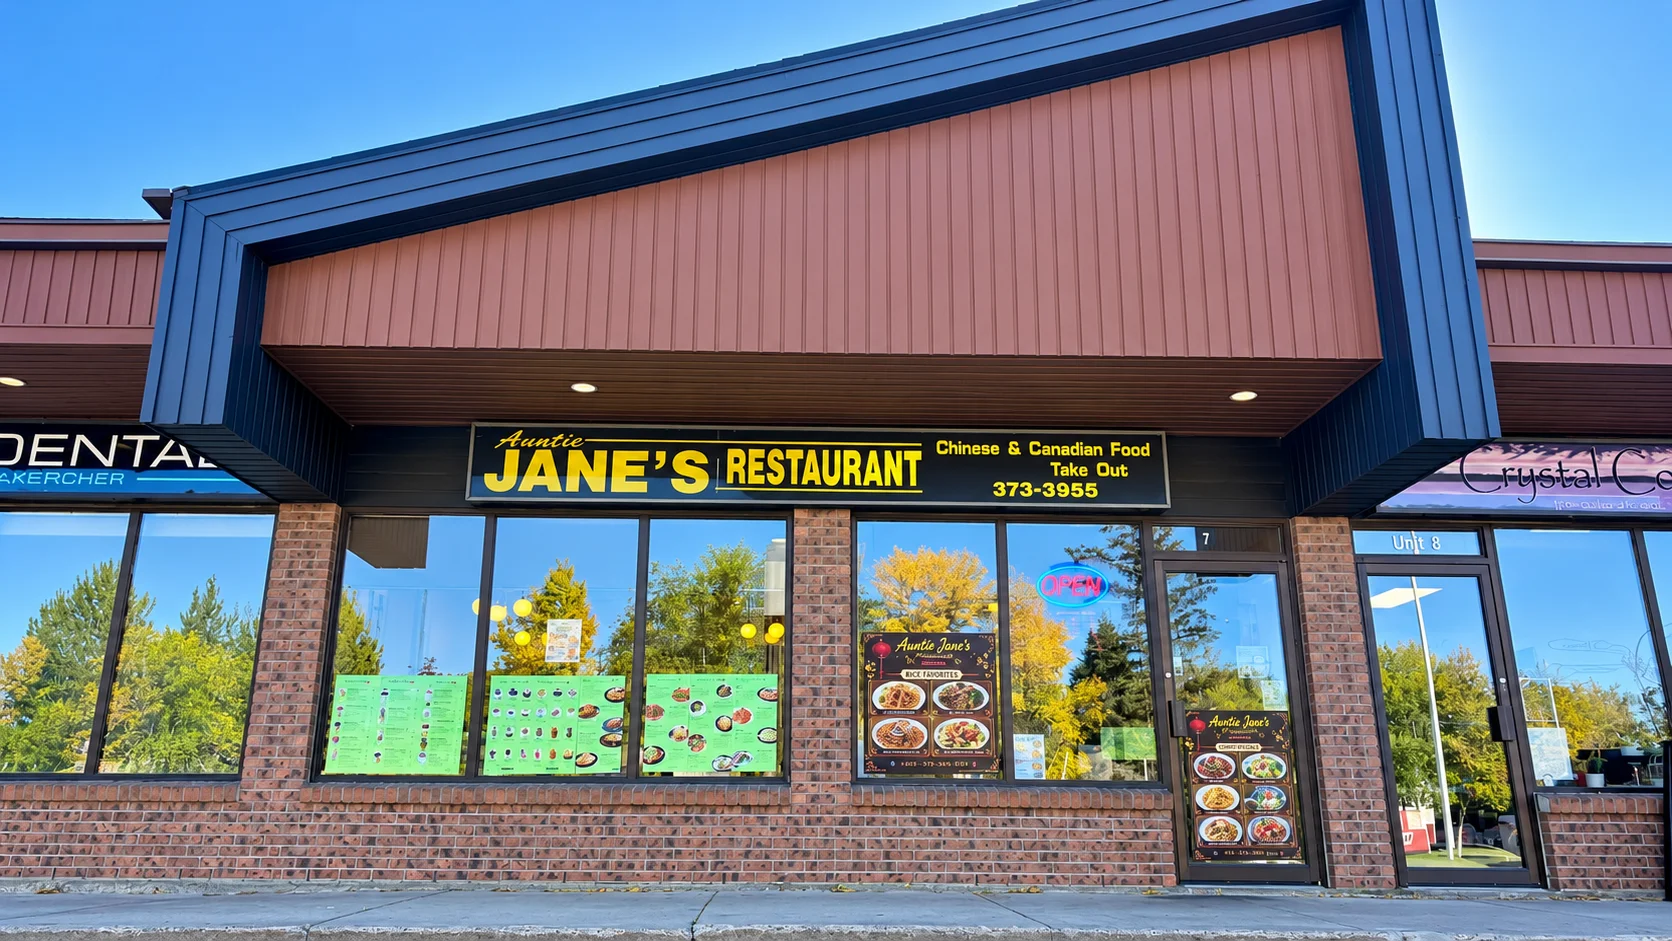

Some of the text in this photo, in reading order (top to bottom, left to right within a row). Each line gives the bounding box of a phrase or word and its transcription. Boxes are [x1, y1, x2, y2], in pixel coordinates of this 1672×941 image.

[494, 429, 584, 449] Auntie
[935, 439, 1151, 457] Chinese & Canadian Food
[483, 447, 923, 494] JANE'S RESTAURANT
[1049, 461, 1129, 478] Take Out
[1459, 445, 1601, 504] Crystal
[992, 481, 1099, 498] 373-3955
[1202, 532, 1210, 545] 7
[1431, 535, 1441, 550] 8
[1041, 574, 1102, 597] OPEN
[895, 636, 971, 654] Auntie Jane's
